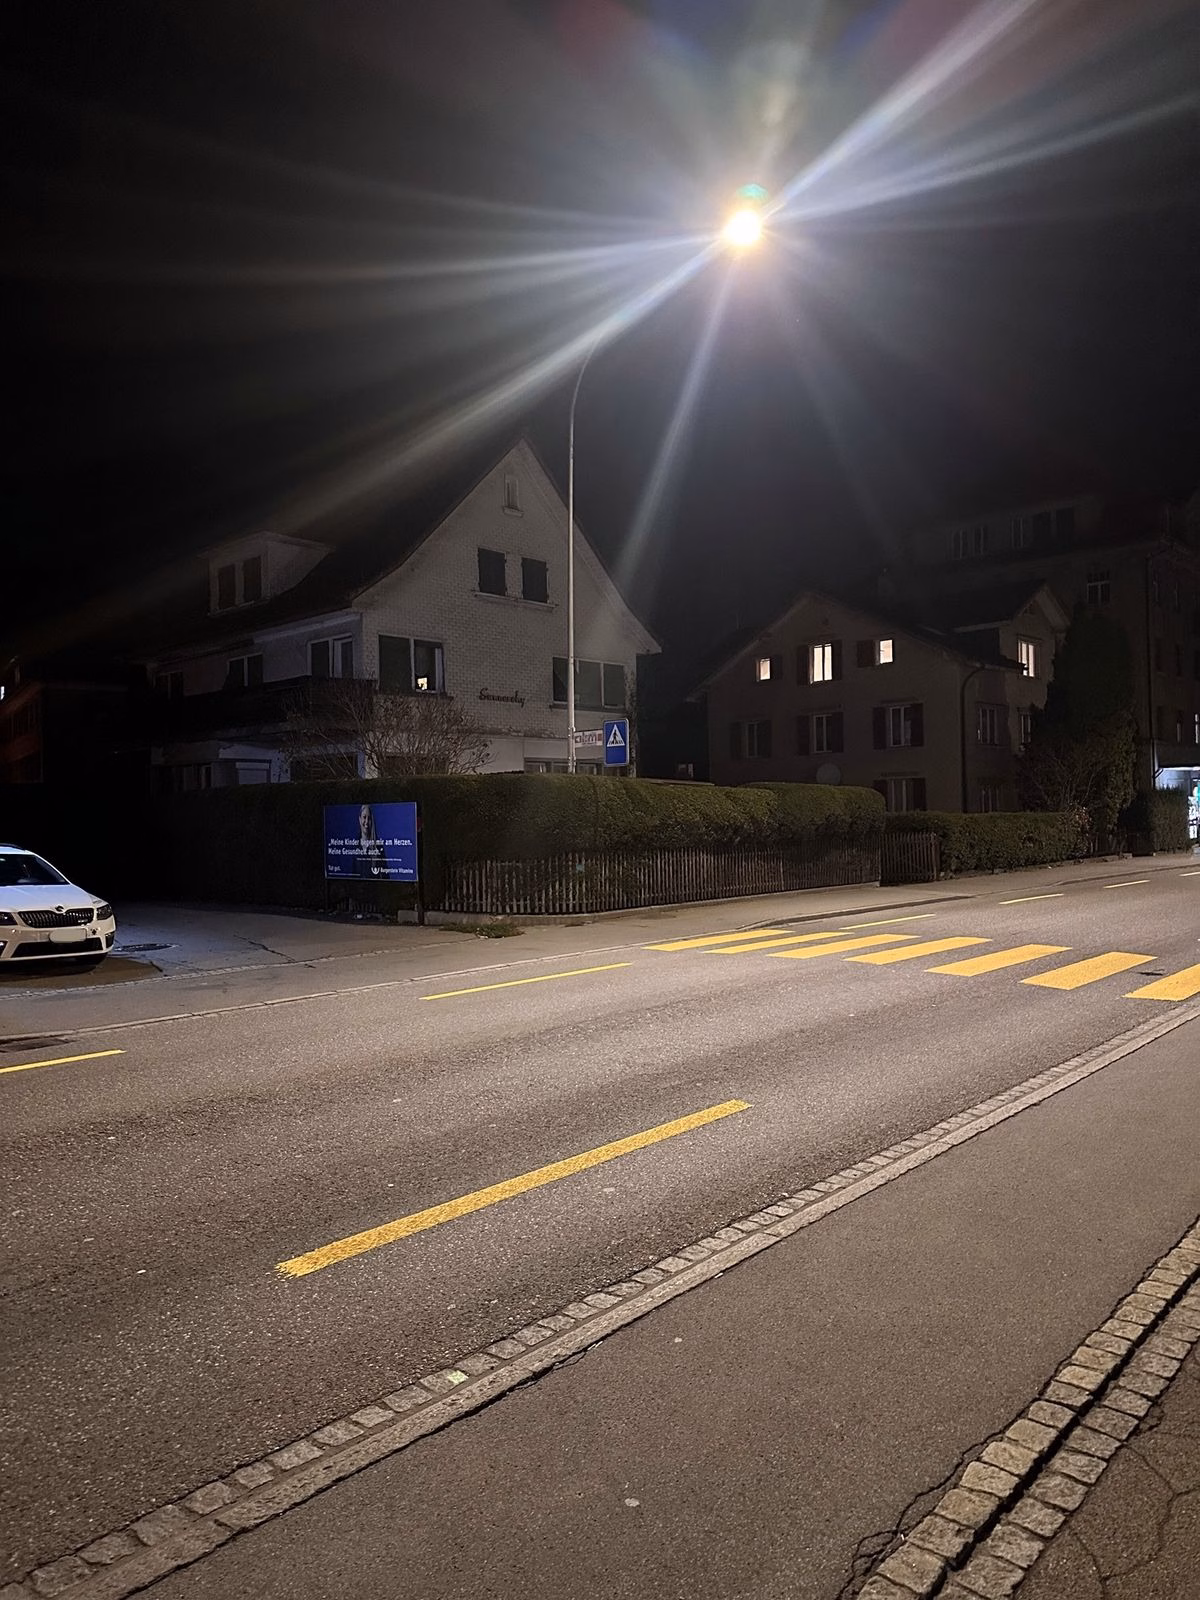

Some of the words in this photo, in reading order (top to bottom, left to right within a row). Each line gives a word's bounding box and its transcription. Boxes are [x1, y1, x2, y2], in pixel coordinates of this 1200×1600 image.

[344, 838, 359, 846] Kinder
[375, 837, 384, 846] mir
[328, 847, 341, 855] Meine
[342, 847, 367, 856] Gesundheit
